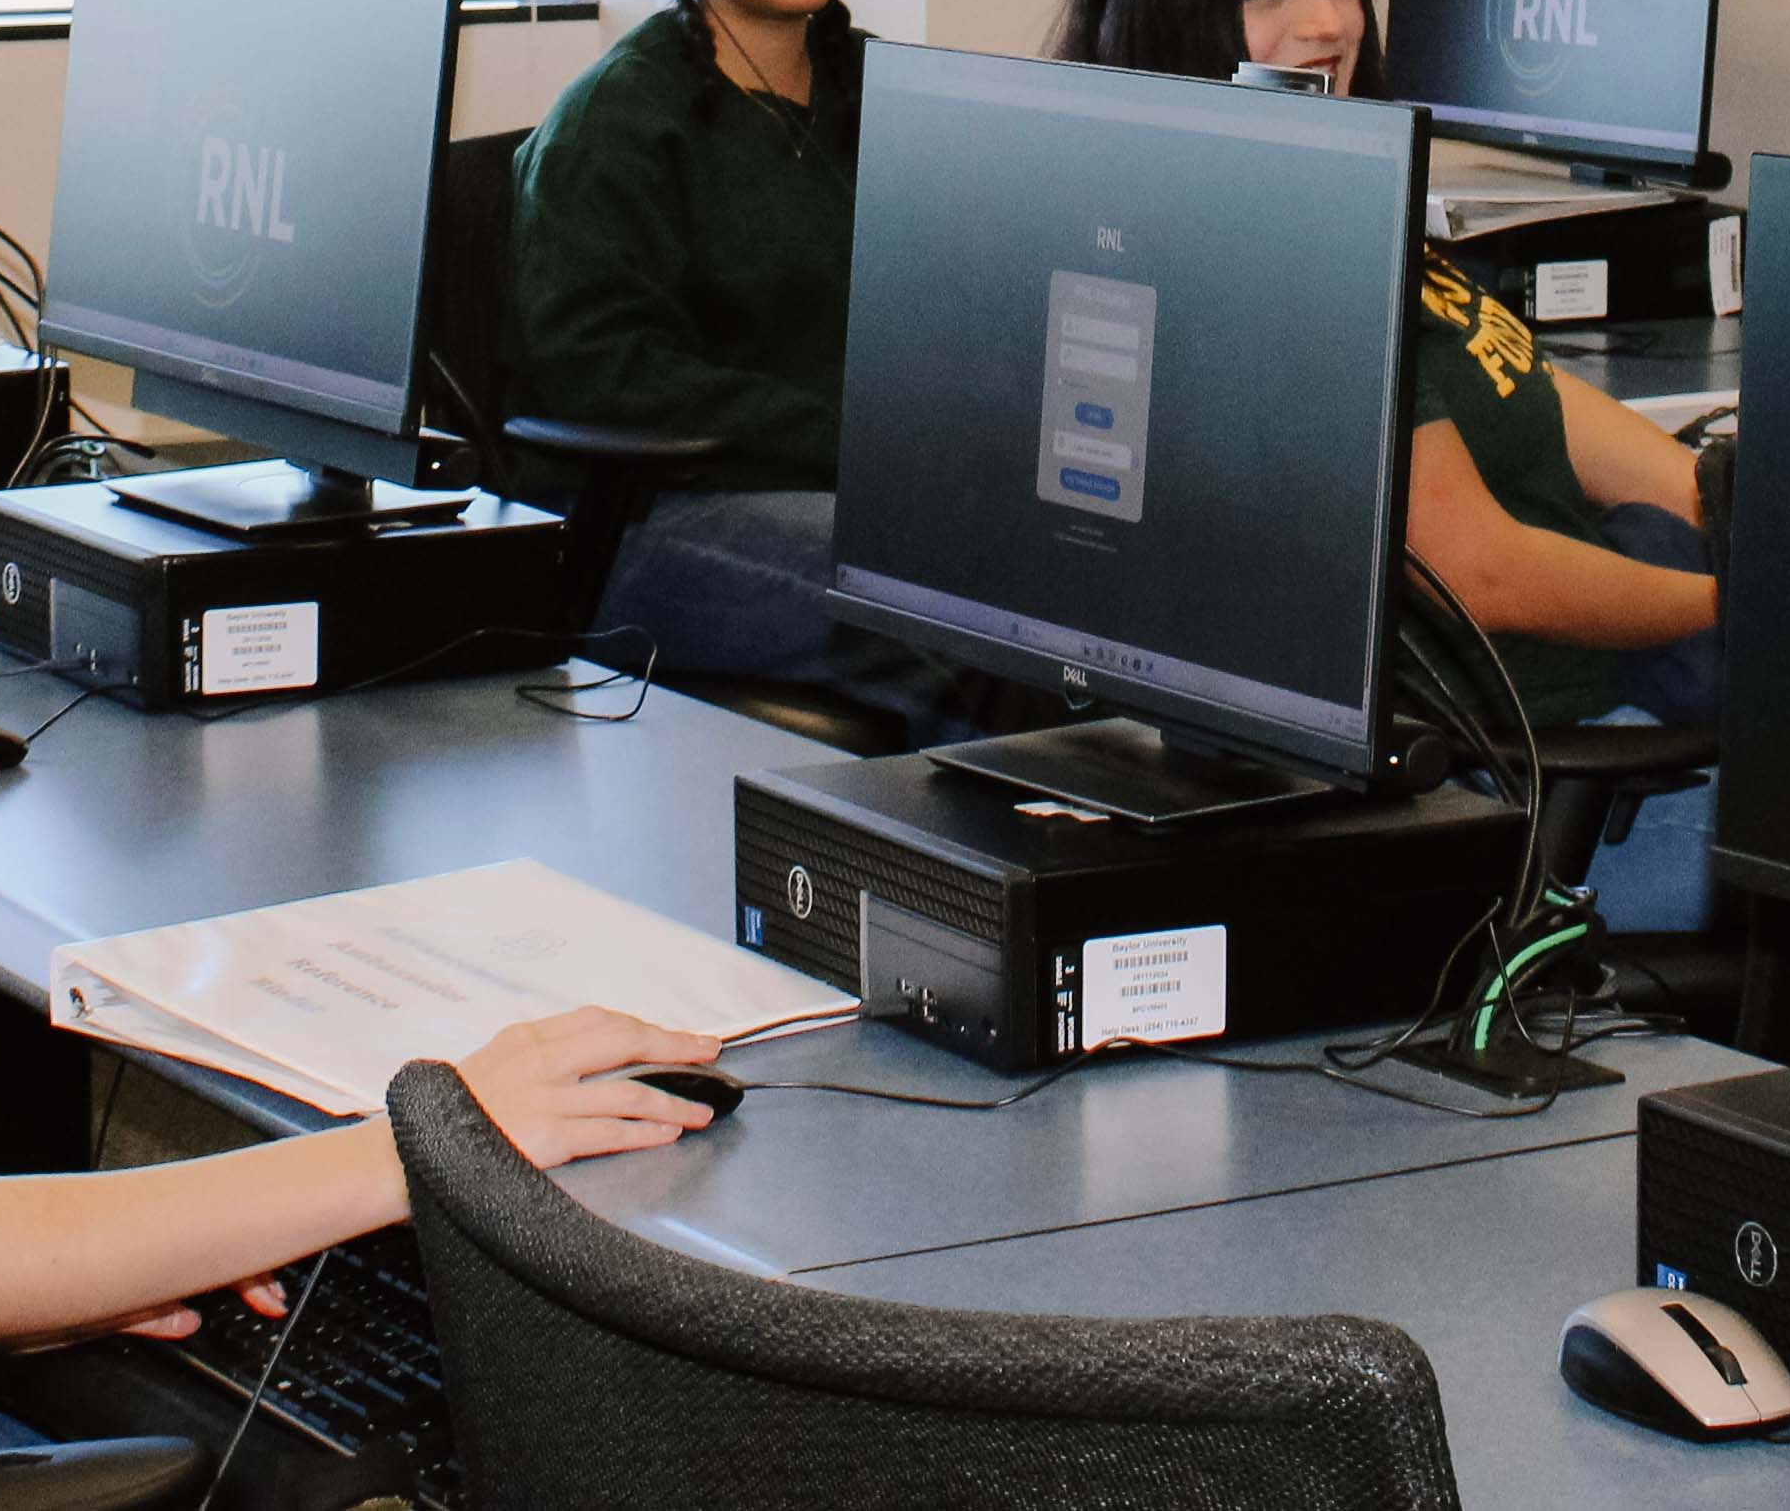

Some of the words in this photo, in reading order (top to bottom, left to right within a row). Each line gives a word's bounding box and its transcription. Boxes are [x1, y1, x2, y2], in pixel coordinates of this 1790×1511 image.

[196, 137, 295, 243] RNL
[1097, 226, 1124, 252] RNL
[1063, 665, 1088, 687] DELL
